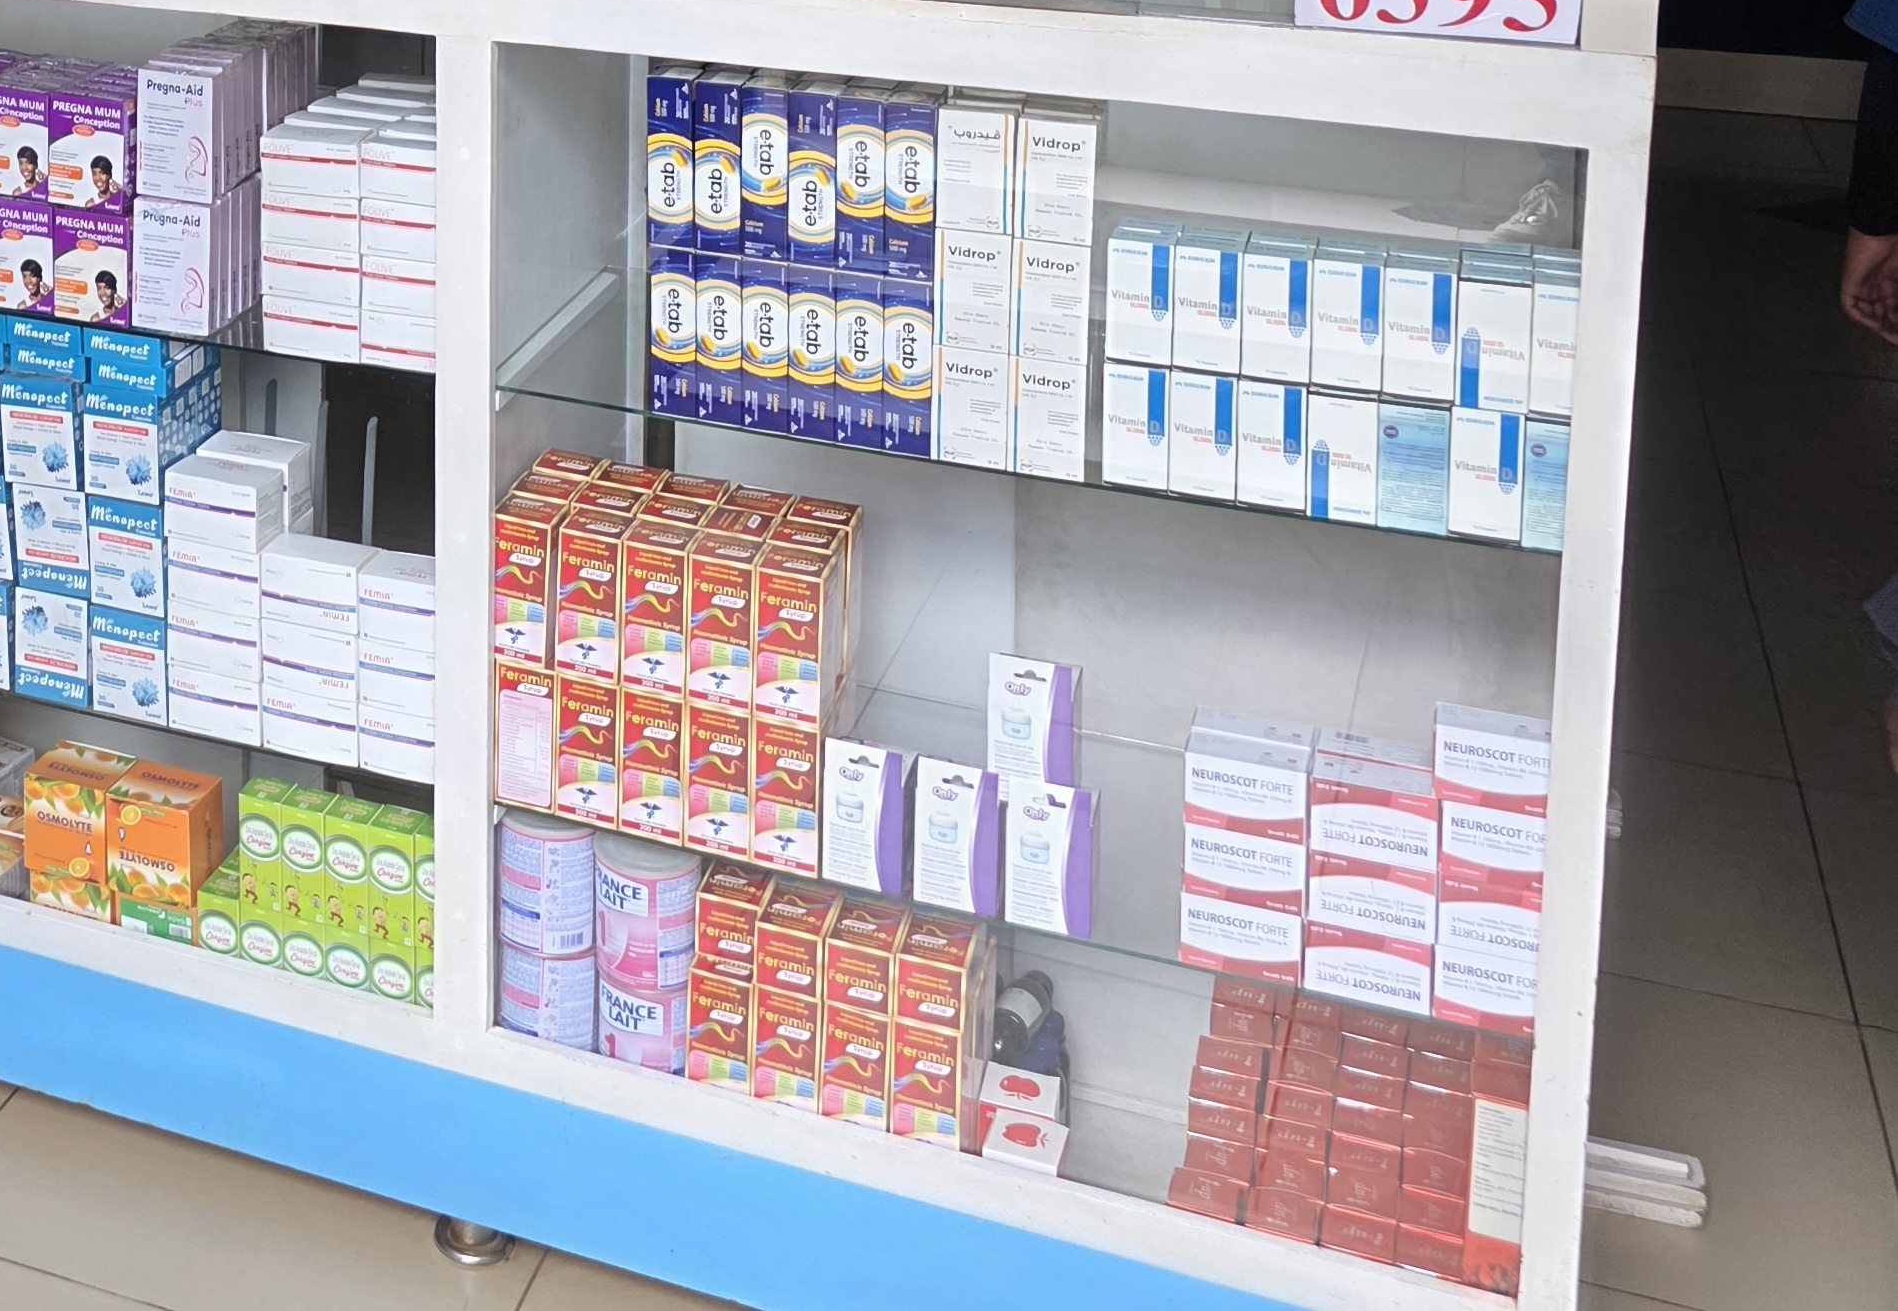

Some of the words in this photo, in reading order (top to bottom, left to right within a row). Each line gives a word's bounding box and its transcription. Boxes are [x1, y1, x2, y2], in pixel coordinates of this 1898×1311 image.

[146, 79, 204, 97] Pregna-Aid
[18, 97, 46, 113] MUM
[52, 99, 92, 116] PREGNA
[93, 104, 122, 120] MUM
[73, 114, 121, 131] Conception
[1032, 135, 1082, 152] Vidrop
[143, 209, 201, 228] Pregna-Aid
[947, 245, 996, 262] Vidrop
[1026, 256, 1075, 274] Vidrop
[1111, 288, 1150, 305] Vitamin
[1177, 296, 1218, 313] Vitamin
[1246, 305, 1287, 322] Vitamin
[14, 322, 72, 347] Menopect
[91, 337, 150, 361] Menopect
[945, 361, 993, 380] Vidrop
[1022, 373, 1071, 391] Vidrop
[2, 383, 69, 407] Menopect
[86, 393, 155, 418] Menopect
[1106, 412, 1146, 429] Vitamin
[91, 505, 158, 533] Menopect
[561, 551, 615, 574] Feramin
[627, 565, 682, 588] Feramin
[693, 579, 749, 600] Feramin
[760, 591, 818, 614] Feramin
[1005, 680, 1033, 697] Only
[561, 698, 614, 719] Feramin
[757, 740, 815, 764] Feramin
[1443, 740, 1516, 763] NEUROSCOT
[141, 770, 201, 791] OSMOLYTE
[838, 766, 866, 783] Only
[1191, 767, 1259, 790] NEUROSCOT
[1260, 780, 1295, 797] FORTE
[36, 810, 93, 834] OSMOLYTE
[1322, 826, 1356, 843] FORTE
[1190, 837, 1258, 861] NEUROSCOT
[1260, 852, 1293, 868] FORTE
[1359, 834, 1429, 857] NEUROSCOT
[118, 849, 176, 874] OSMOLYTE
[1187, 908, 1254, 931] NEUROSCOT
[1256, 922, 1290, 939] FORTE
[828, 969, 888, 994] Feramin
[601, 985, 657, 1020] FRANCE
[608, 1004, 643, 1031] LAIT
